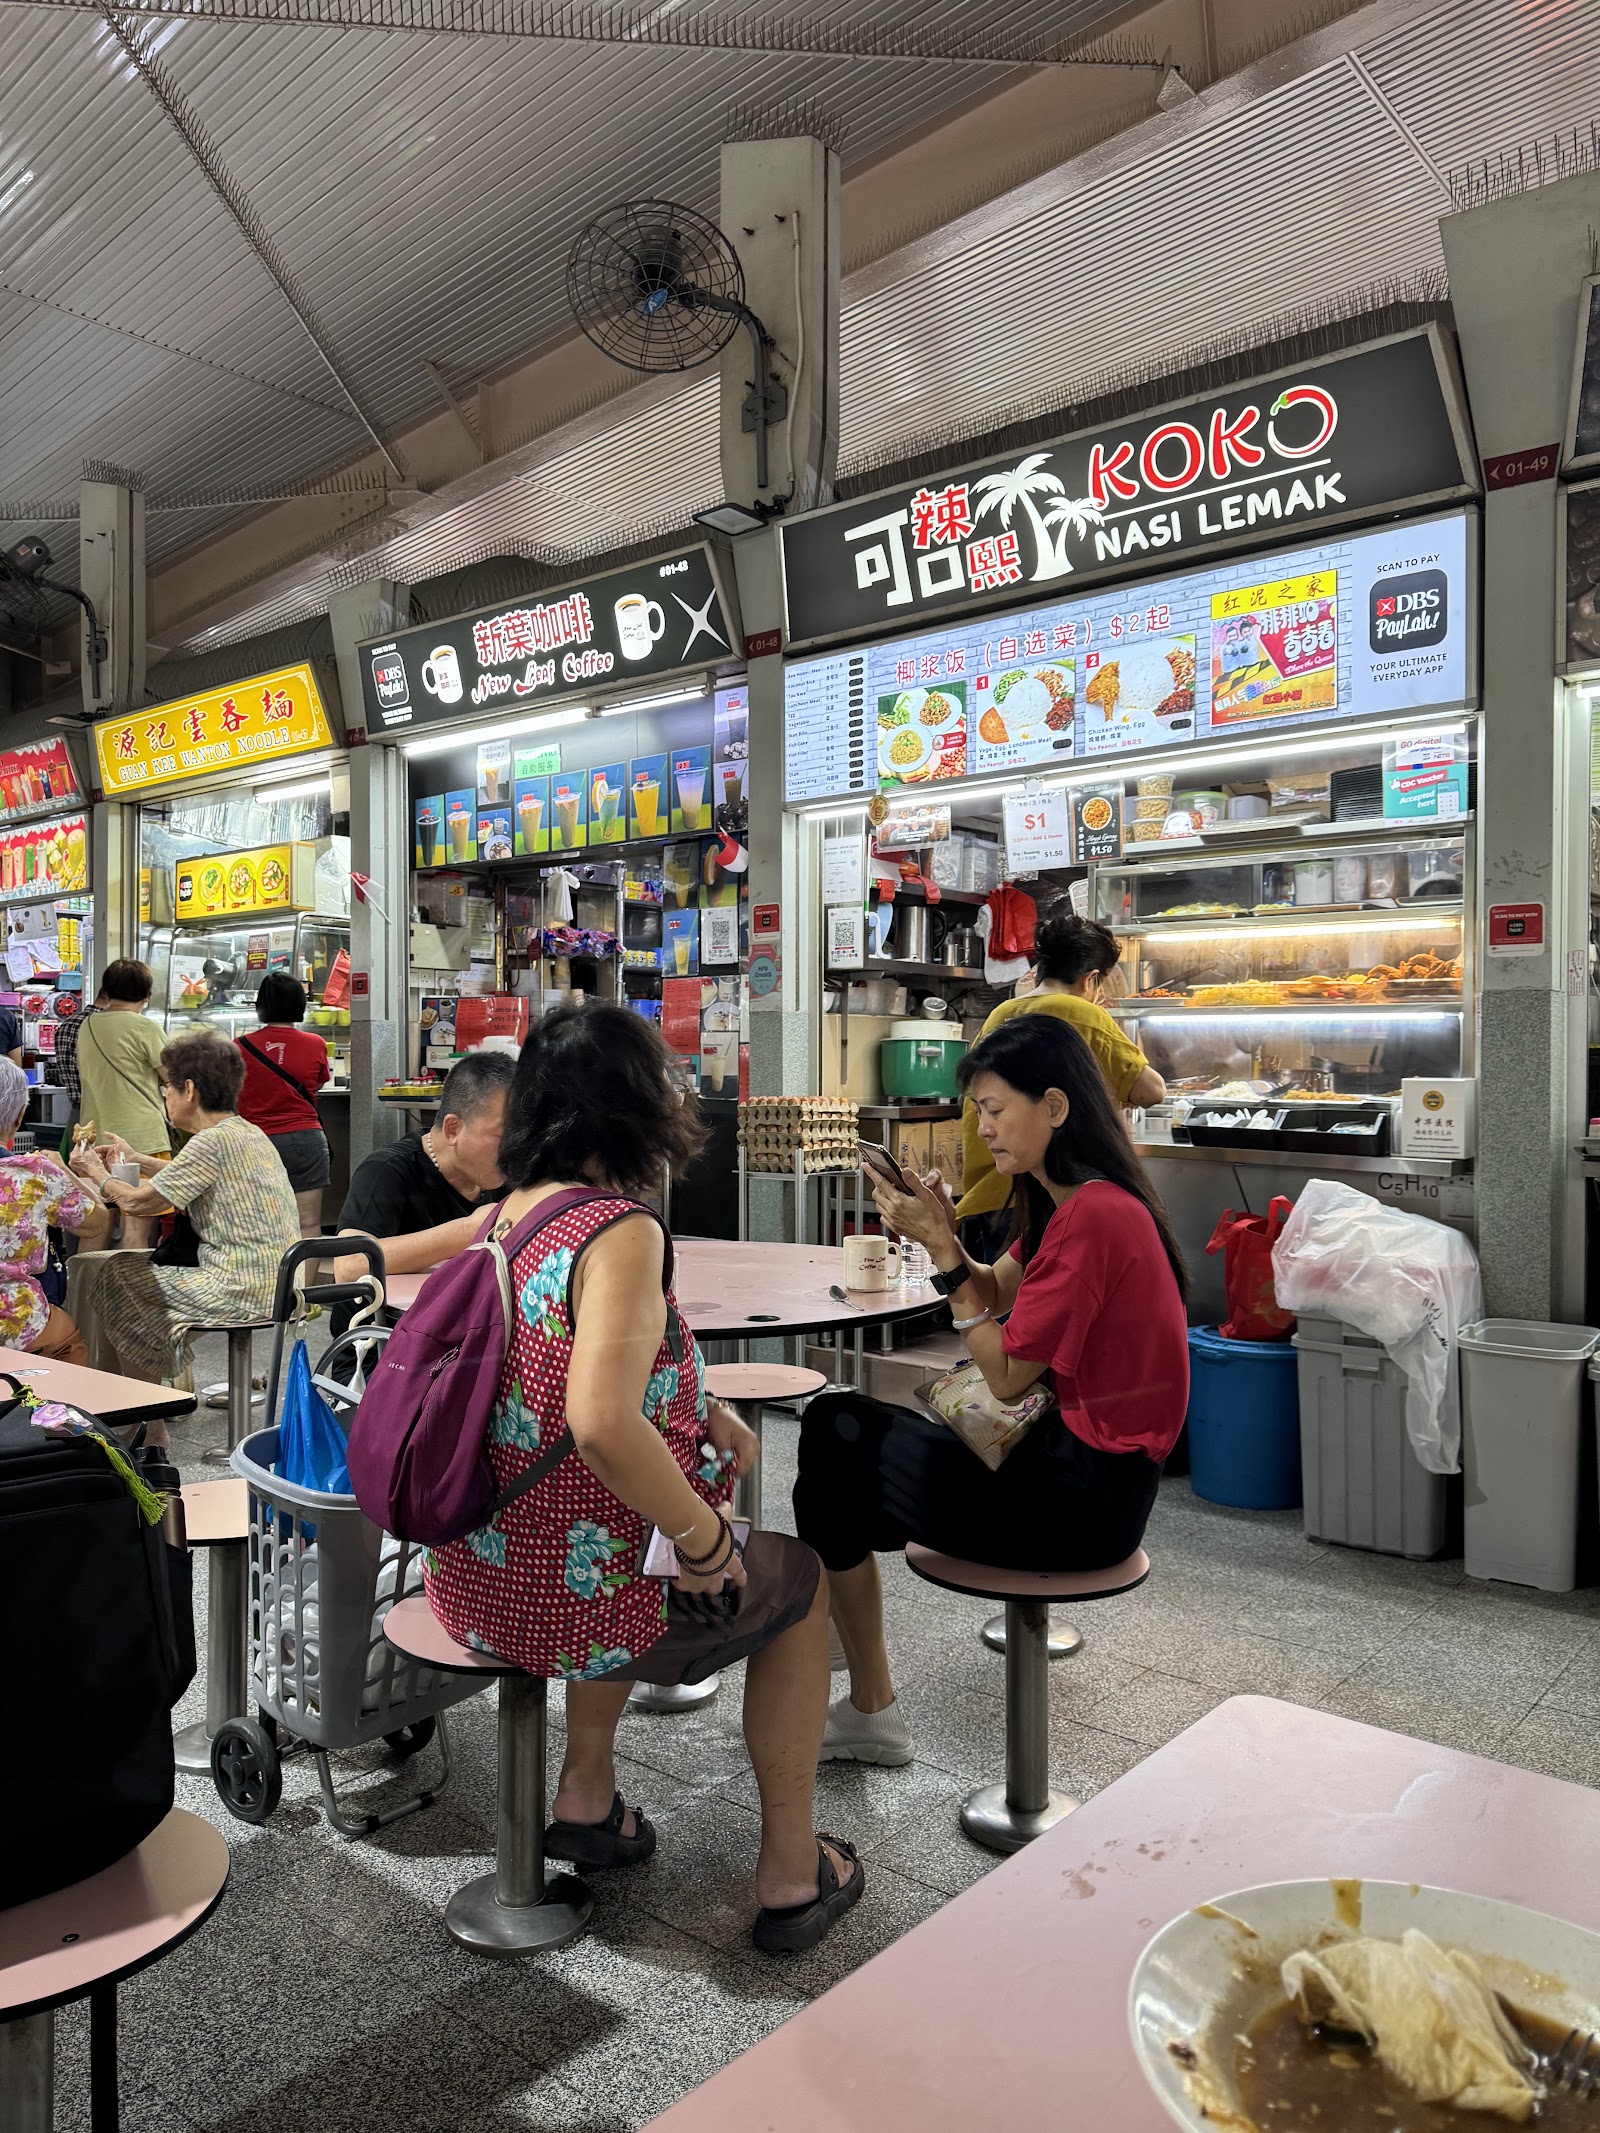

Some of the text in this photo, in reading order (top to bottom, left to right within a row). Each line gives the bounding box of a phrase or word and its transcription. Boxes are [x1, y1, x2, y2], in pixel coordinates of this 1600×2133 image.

[1088, 385, 1338, 510] KOKO
[1505, 455, 1549, 478] 01-49
[1094, 472, 1347, 561] NASI LEMAK
[1376, 554, 1441, 573] SCAN TO PAY
[1223, 576, 1325, 613] 红泥之家
[1396, 588, 1440, 613] DBS
[472, 591, 594, 667] 新葉咖啡
[1375, 611, 1440, 639] PayLah!
[1088, 655, 1098, 667] 2
[1370, 653, 1448, 672] YOUR ULTIMATE
[384, 665, 402, 682] DBS
[471, 651, 615, 704] New Leaf Coffee
[1373, 665, 1444, 682] EVERYDAY APP
[979, 678, 987, 689] 1
[1088, 726, 1112, 736] Chicken
[1133, 721, 1146, 730] Egg
[1009, 740, 1037, 749] Luncheon
[1097, 742, 1118, 750] Peanut
[1400, 740, 1413, 749] GO
[119, 727, 290, 782] GUAN KEE WANTON NOODLE
[1400, 773, 1445, 788] CDC Voucher
[1399, 790, 1435, 804] Accepted
[1417, 798, 1436, 808] here
[1024, 812, 1046, 831] $1
[1044, 850, 1063, 858] $1.50
